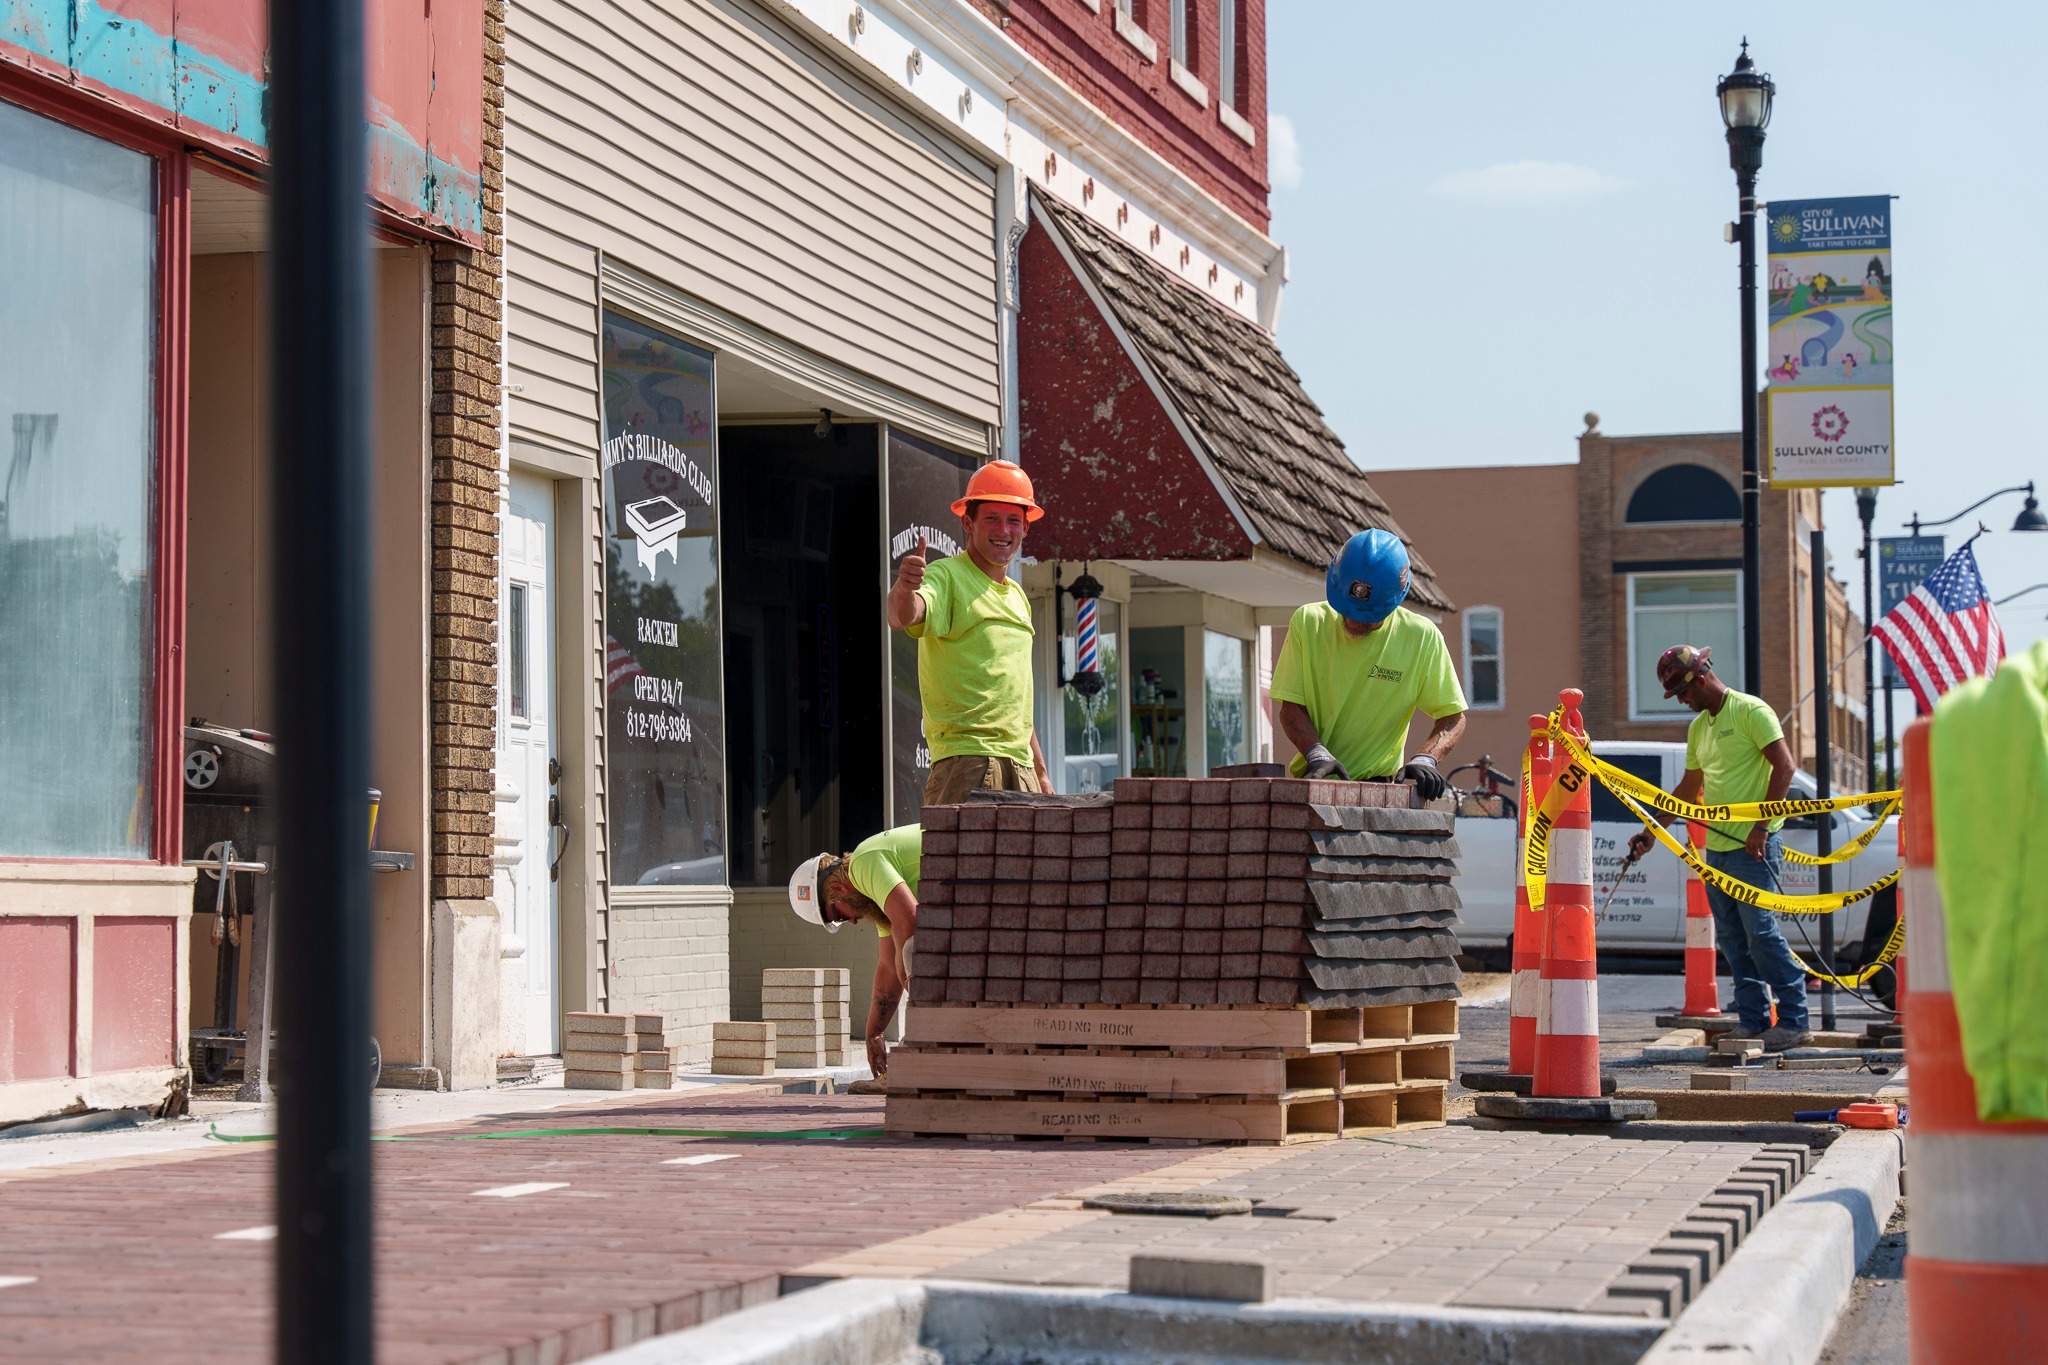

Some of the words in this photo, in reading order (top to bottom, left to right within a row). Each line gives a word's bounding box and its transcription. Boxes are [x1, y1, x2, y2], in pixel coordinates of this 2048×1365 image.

[1802, 209, 1820, 218] CITY
[1822, 208, 1833, 216] OF
[1802, 215, 1884, 233] SULLIVAN
[1808, 240, 1825, 248] TAKE
[1774, 446, 1832, 457] SULLIVAN
[1836, 444, 1889, 455] COUNTY
[636, 433, 686, 479] BILLIARDS
[688, 460, 712, 506] CLUB
[892, 522, 919, 560] JIMMY'S
[1886, 562, 1927, 576] TAKE
[1886, 580, 1923, 600] TI
[637, 616, 678, 648] RACK'EM
[634, 674, 659, 702] OPEN
[661, 677, 683, 707] 24/7
[626, 706, 692, 743] 812-798-3384
[1653, 792, 1731, 821] CAUTION
[1528, 811, 1552, 876] CAUTION
[1594, 837, 1616, 850] The
[1033, 1018, 1091, 1033] READING
[1099, 1022, 1134, 1037] ROCK
[1048, 1076, 1106, 1091] READING
[1041, 1114, 1101, 1126] READING
